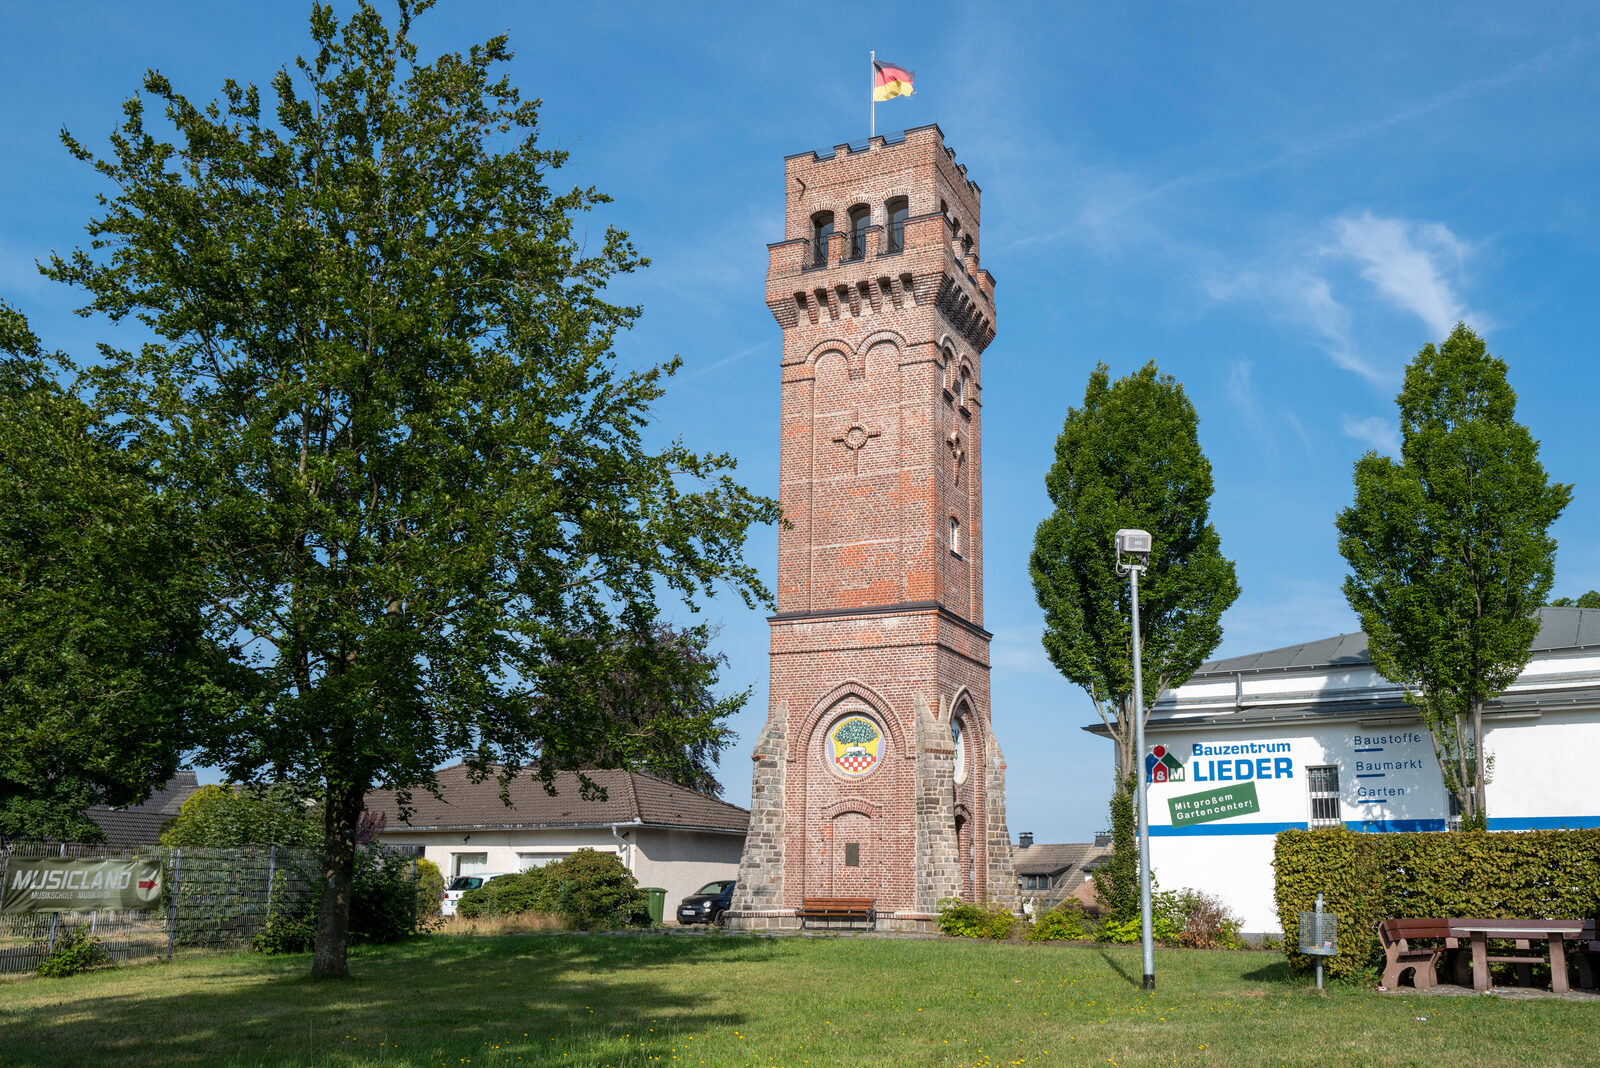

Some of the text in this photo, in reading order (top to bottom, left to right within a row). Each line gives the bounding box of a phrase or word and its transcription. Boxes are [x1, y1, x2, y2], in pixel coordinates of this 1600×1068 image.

[1354, 733, 1421, 746] Baustoffe
[1192, 742, 1291, 757] Bauzentrum
[1193, 757, 1293, 782] LIEDER
[1356, 759, 1423, 772] Baumarkt
[1357, 786, 1405, 797] Garten
[1174, 794, 1233, 811] Mit großem
[1176, 800, 1254, 820] Gartencenter!
[11, 869, 132, 890] MUSICLAND
[30, 891, 74, 900] MUSIKSCHULE
